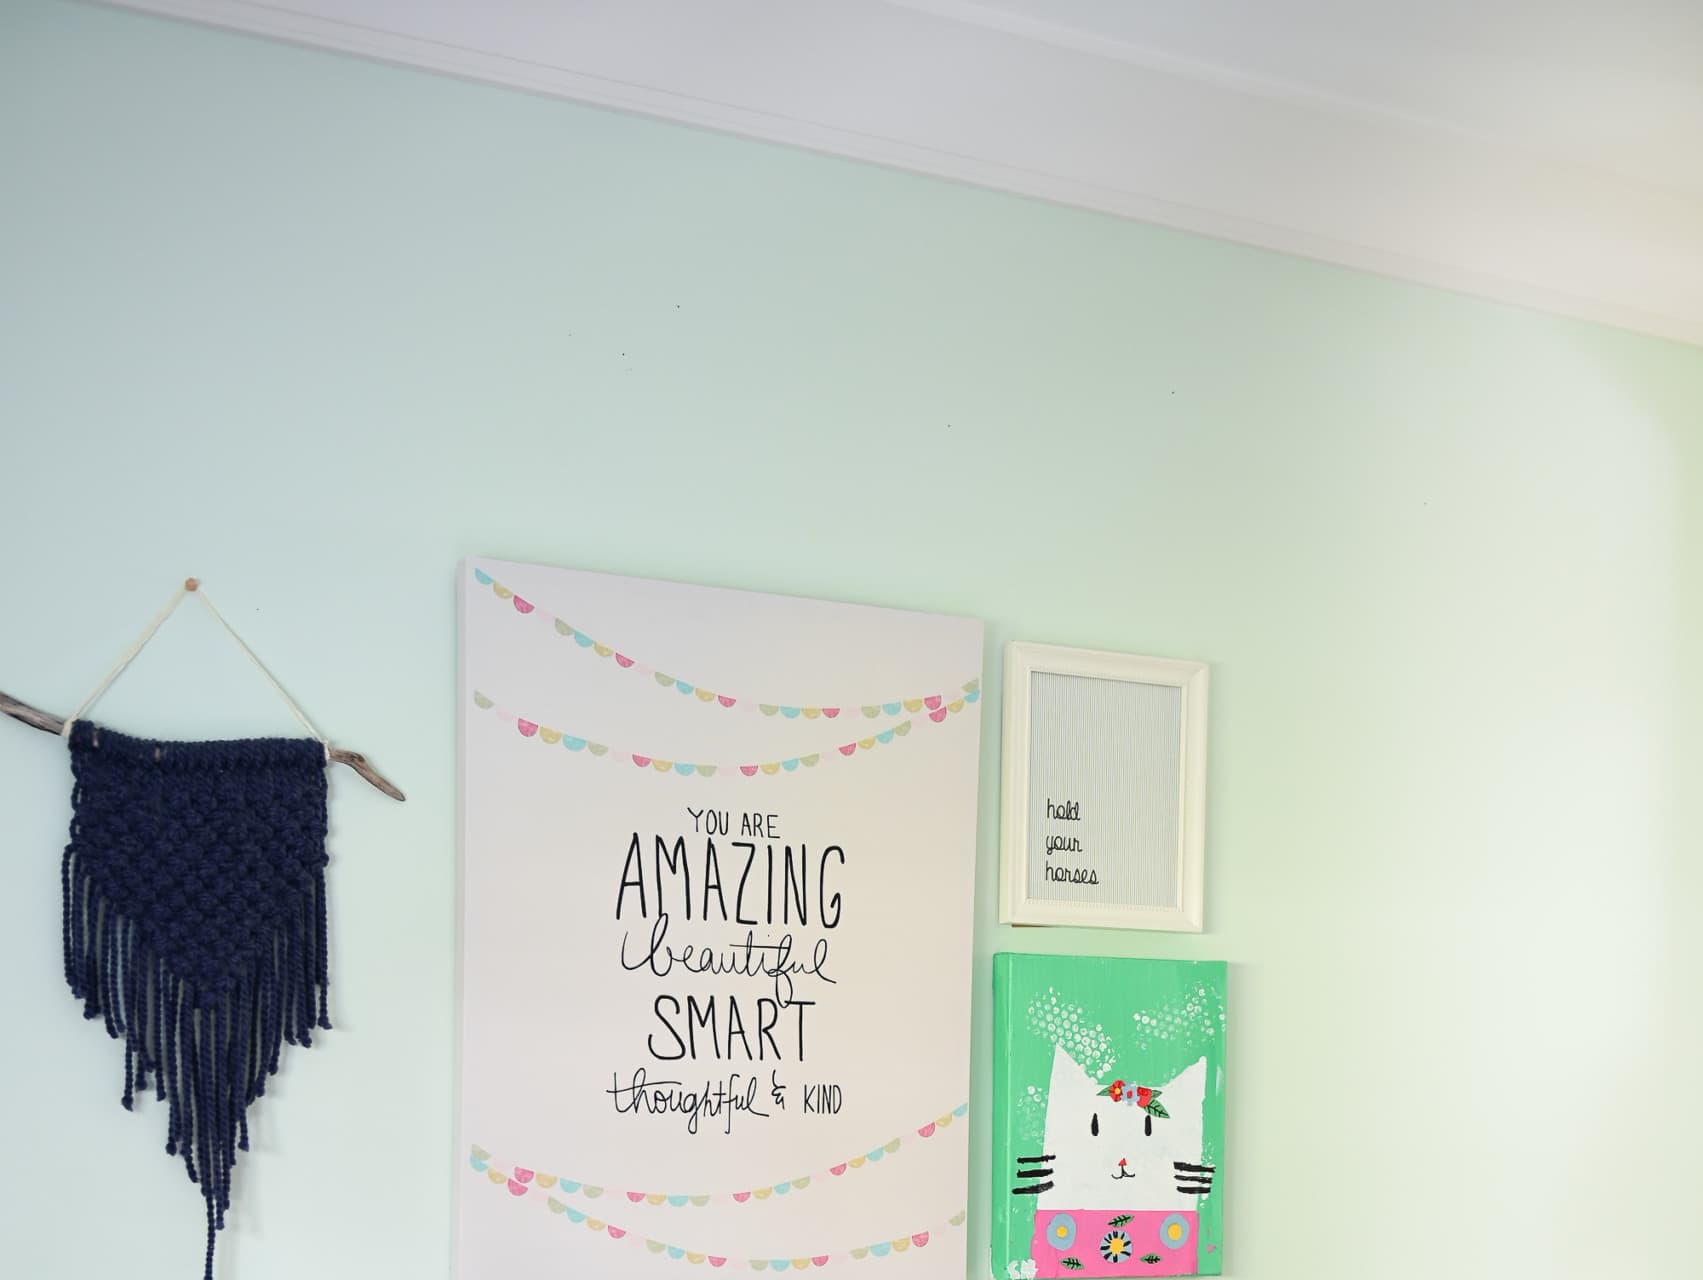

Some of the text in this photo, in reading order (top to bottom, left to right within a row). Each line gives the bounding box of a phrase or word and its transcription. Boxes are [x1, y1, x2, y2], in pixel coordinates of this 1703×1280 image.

[687, 807, 781, 838] YOU ARE
[1047, 798, 1080, 821] hold
[1046, 835, 1083, 856] your
[616, 832, 845, 929] AMAZING
[1046, 860, 1100, 885] horses
[621, 912, 837, 1009] beautiful
[648, 994, 816, 1061] SMART
[606, 1067, 770, 1134] thoughtful
[803, 1084, 842, 1115] KIND
